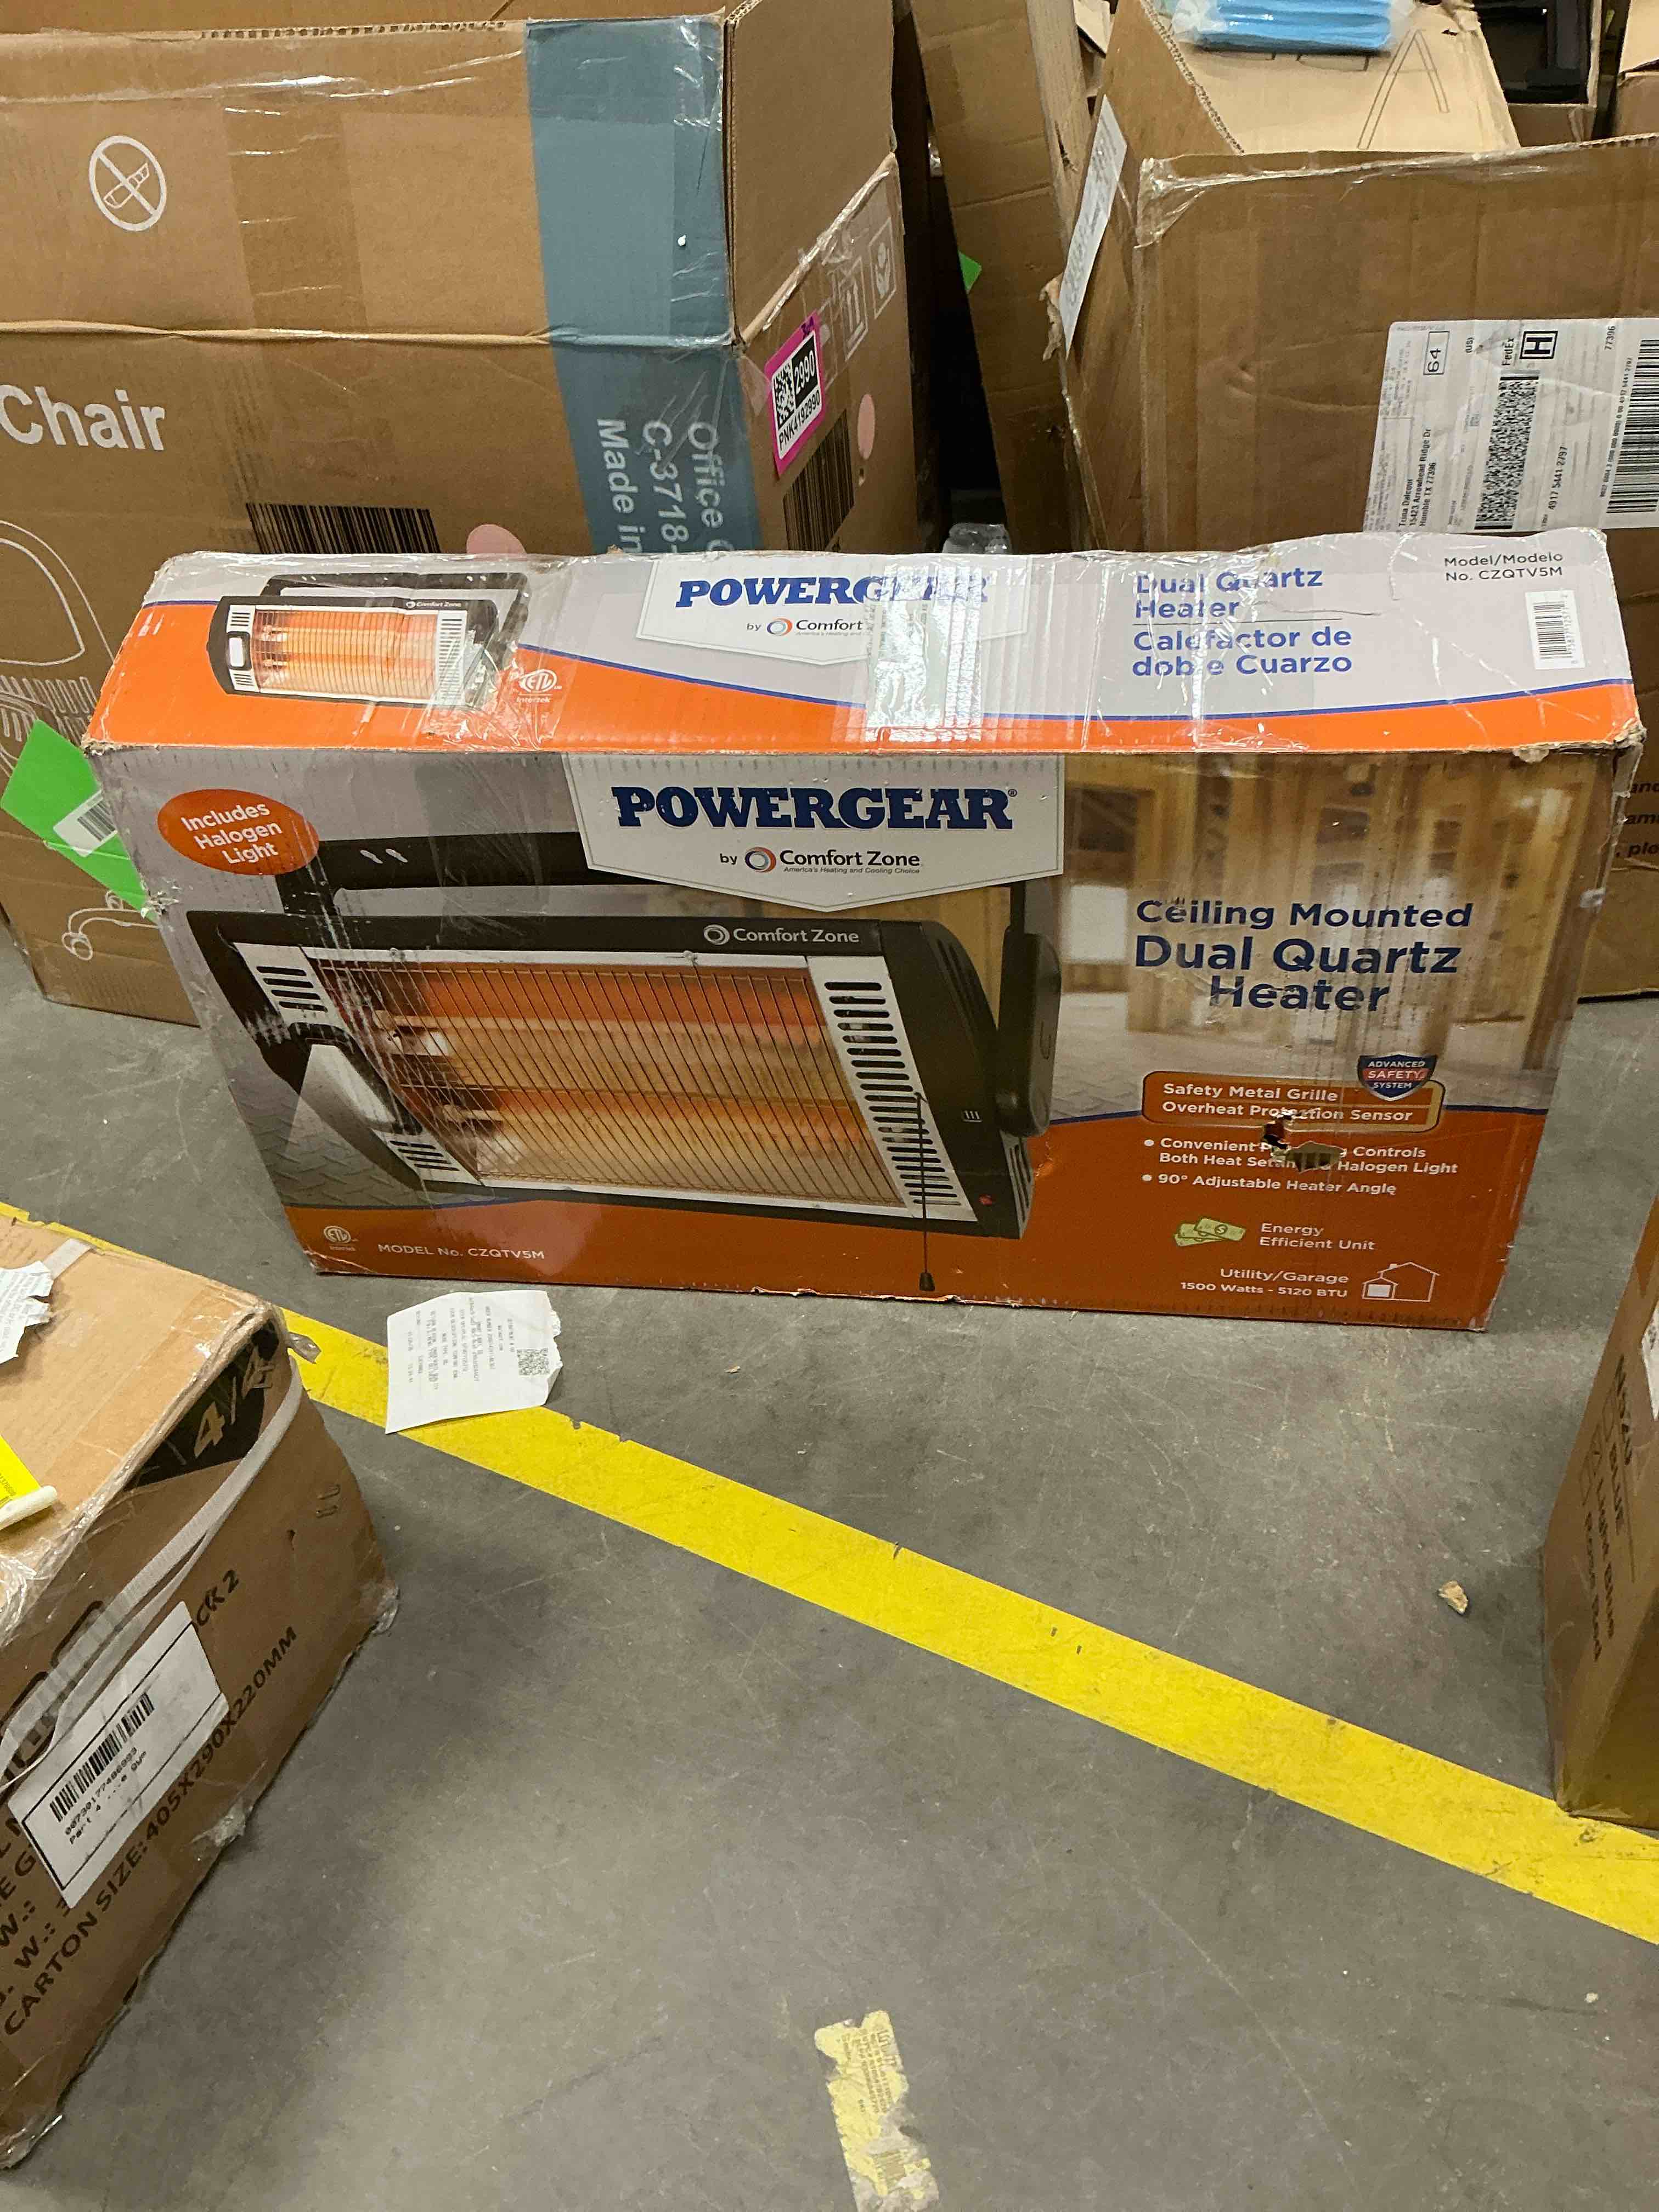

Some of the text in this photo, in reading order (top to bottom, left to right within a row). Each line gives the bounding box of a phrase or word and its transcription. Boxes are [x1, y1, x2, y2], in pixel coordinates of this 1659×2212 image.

[1465, 336, 1476, 353] (US)
[1523, 337, 1553, 355] H
[1604, 325, 1616, 351] 77396
[1427, 347, 1441, 373] 64
[1501, 337, 1515, 366] FedEx
[794, 350, 815, 393] 2990
[0, 383, 165, 451] Chair
[778, 389, 821, 450] PNK4192990
[1423, 428, 1431, 437] Dr
[1419, 440, 1430, 461] Ridge
[688, 421, 725, 528] Office
[1413, 464, 1426, 503] Arrowhead
[1426, 462, 1436, 484] 77396
[1548, 446, 1567, 510] 4917 5441 2797
[597, 419, 646, 553] Made in
[1424, 487, 1431, 496] TX
[1444, 552, 1563, 567] Model/Modelo
[1137, 573, 1204, 593] Dual
[1446, 567, 1562, 581] No. CZQTV5M
[1136, 600, 1239, 618] Heater
[746, 619, 863, 631] by Comfort
[1312, 626, 1352, 646] de
[1132, 654, 1352, 676] dobe Cuarzo
[180, 803, 270, 831] Includes
[612, 786, 1013, 831] POWERGEAR
[194, 822, 283, 850] Halogen
[221, 842, 278, 865] Light
[719, 849, 920, 866] by Comfort Zone
[1136, 899, 1473, 929] Ceiling Mounted
[733, 927, 859, 943] Comfort Zone
[1135, 934, 1462, 974] Dual Quartz
[1209, 974, 1390, 1011] Heater
[1368, 1070, 1421, 1079] SAFETY
[1163, 1083, 1338, 1102] Safety Metal Grille
[1162, 1101, 1244, 1115] Overheat
[1350, 1109, 1413, 1121] Sensor
[1160, 1138, 1256, 1153] Convenient
[1352, 1146, 1426, 1159] Controls
[1159, 1152, 1198, 1164] Both
[1204, 1155, 1243, 1166] Heat
[1338, 1161, 1408, 1175] Halogen
[1413, 1163, 1458, 1176] Light
[1158, 1173, 1396, 1195] 90° Adjustable Heater Angle
[1261, 1223, 1324, 1237] Energy
[377, 1244, 545, 1259] MODEL No. CZQTV5M
[1259, 1237, 1376, 1250] Efficient Unit
[1220, 1268, 1350, 1285] Utility/Garage
[1180, 1282, 1216, 1291] 1500
[1221, 1283, 1263, 1294] Watts
[1277, 1286, 1313, 1296] 5120
[1316, 1288, 1348, 1298] BTU
[223, 1569, 239, 1593] 2
[4, 1911, 98, 2035] CARTON
